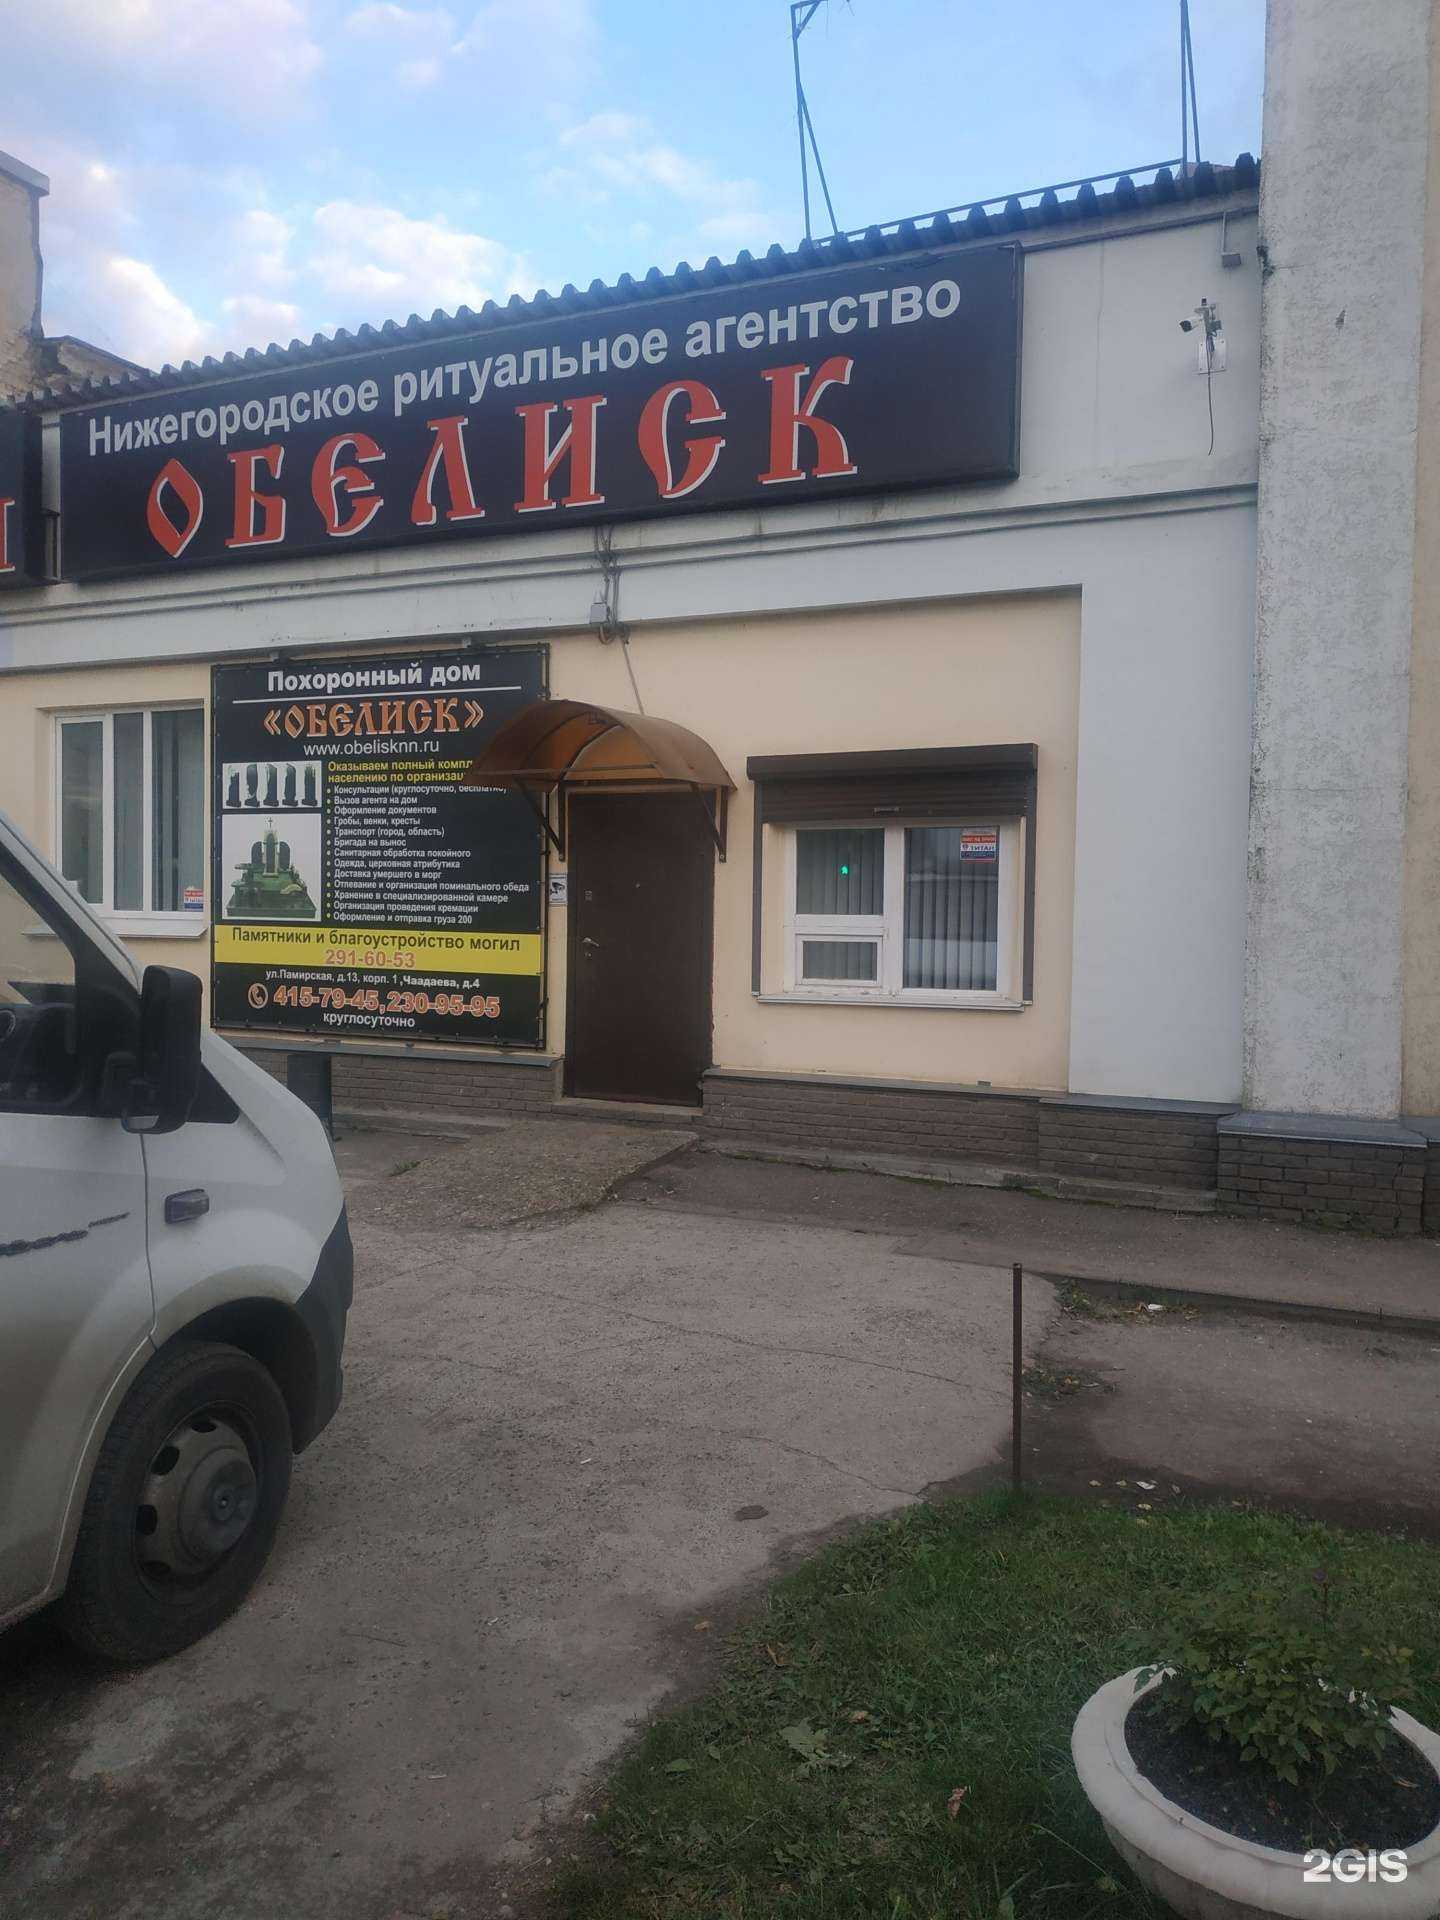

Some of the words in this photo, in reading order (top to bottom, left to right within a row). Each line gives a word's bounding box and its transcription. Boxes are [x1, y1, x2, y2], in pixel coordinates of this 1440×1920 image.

[88, 378, 380, 457] Нижегородское
[393, 327, 669, 416] ритуальное
[685, 278, 962, 359] агентство
[146, 354, 859, 560] ОБЕЛИСК
[268, 662, 423, 694] Похоронный
[430, 664, 481, 687] дом
[263, 697, 484, 739] «ОБЕЛИСК»
[304, 738, 440, 757] www.obelisknn.ru
[328, 760, 388, 772] Оказываем
[391, 759, 435, 770] полный
[438, 760, 473, 769] компл
[328, 774, 387, 783] населению
[390, 773, 404, 782] по
[334, 785, 390, 796] Консультации
[391, 785, 457, 795] (круглосуточно,
[334, 796, 360, 805] Вызов
[361, 797, 388, 805] агента
[389, 797, 400, 805] на
[400, 797, 418, 805] дом
[334, 806, 387, 816] Оформление
[388, 807, 437, 816] документов
[334, 816, 362, 826] Гробы,
[363, 818, 389, 826] венки,
[391, 818, 421, 826] кресты
[334, 826, 376, 837] Транспорт
[377, 826, 406, 837] (город,
[407, 827, 445, 838] область)
[334, 838, 367, 847] Бригада
[368, 839, 378, 847] на
[379, 839, 407, 847] вынос
[334, 848, 381, 858] Санитарная
[383, 848, 426, 858] обработка
[427, 848, 471, 858] покойного
[334, 858, 367, 868] Одежда,
[368, 860, 411, 868] церковная
[413, 859, 461, 869] атрибутика
[334, 869, 371, 879] Доставка
[372, 871, 413, 879] умершего
[421, 872, 442, 880] морг
[334, 880, 377, 889] Отпевание
[385, 881, 438, 890] организация
[439, 882, 501, 891] поминального
[503, 882, 529, 892] обеда
[334, 890, 374, 900] Хранение
[375, 892, 381, 900] в
[382, 892, 475, 903] специализированной
[476, 894, 509, 904] камере
[333, 901, 385, 911] Организация
[386, 903, 436, 912] проведения
[437, 904, 479, 914] кремации
[333, 912, 386, 922] Оформление
[394, 914, 432, 924] отправка
[433, 916, 456, 925] груза
[457, 915, 473, 924] 200
[232, 926, 312, 944] Памятники
[316, 932, 325, 943] и
[329, 930, 465, 951] благоустройство
[469, 940, 521, 951] могил
[325, 949, 416, 969] 291-60-53
[336, 972, 360, 984] д.13,
[362, 974, 390, 985] корп.
[392, 975, 398, 984] 1
[462, 978, 481, 989] д.4
[323, 1012, 416, 1028] круглосуточно
